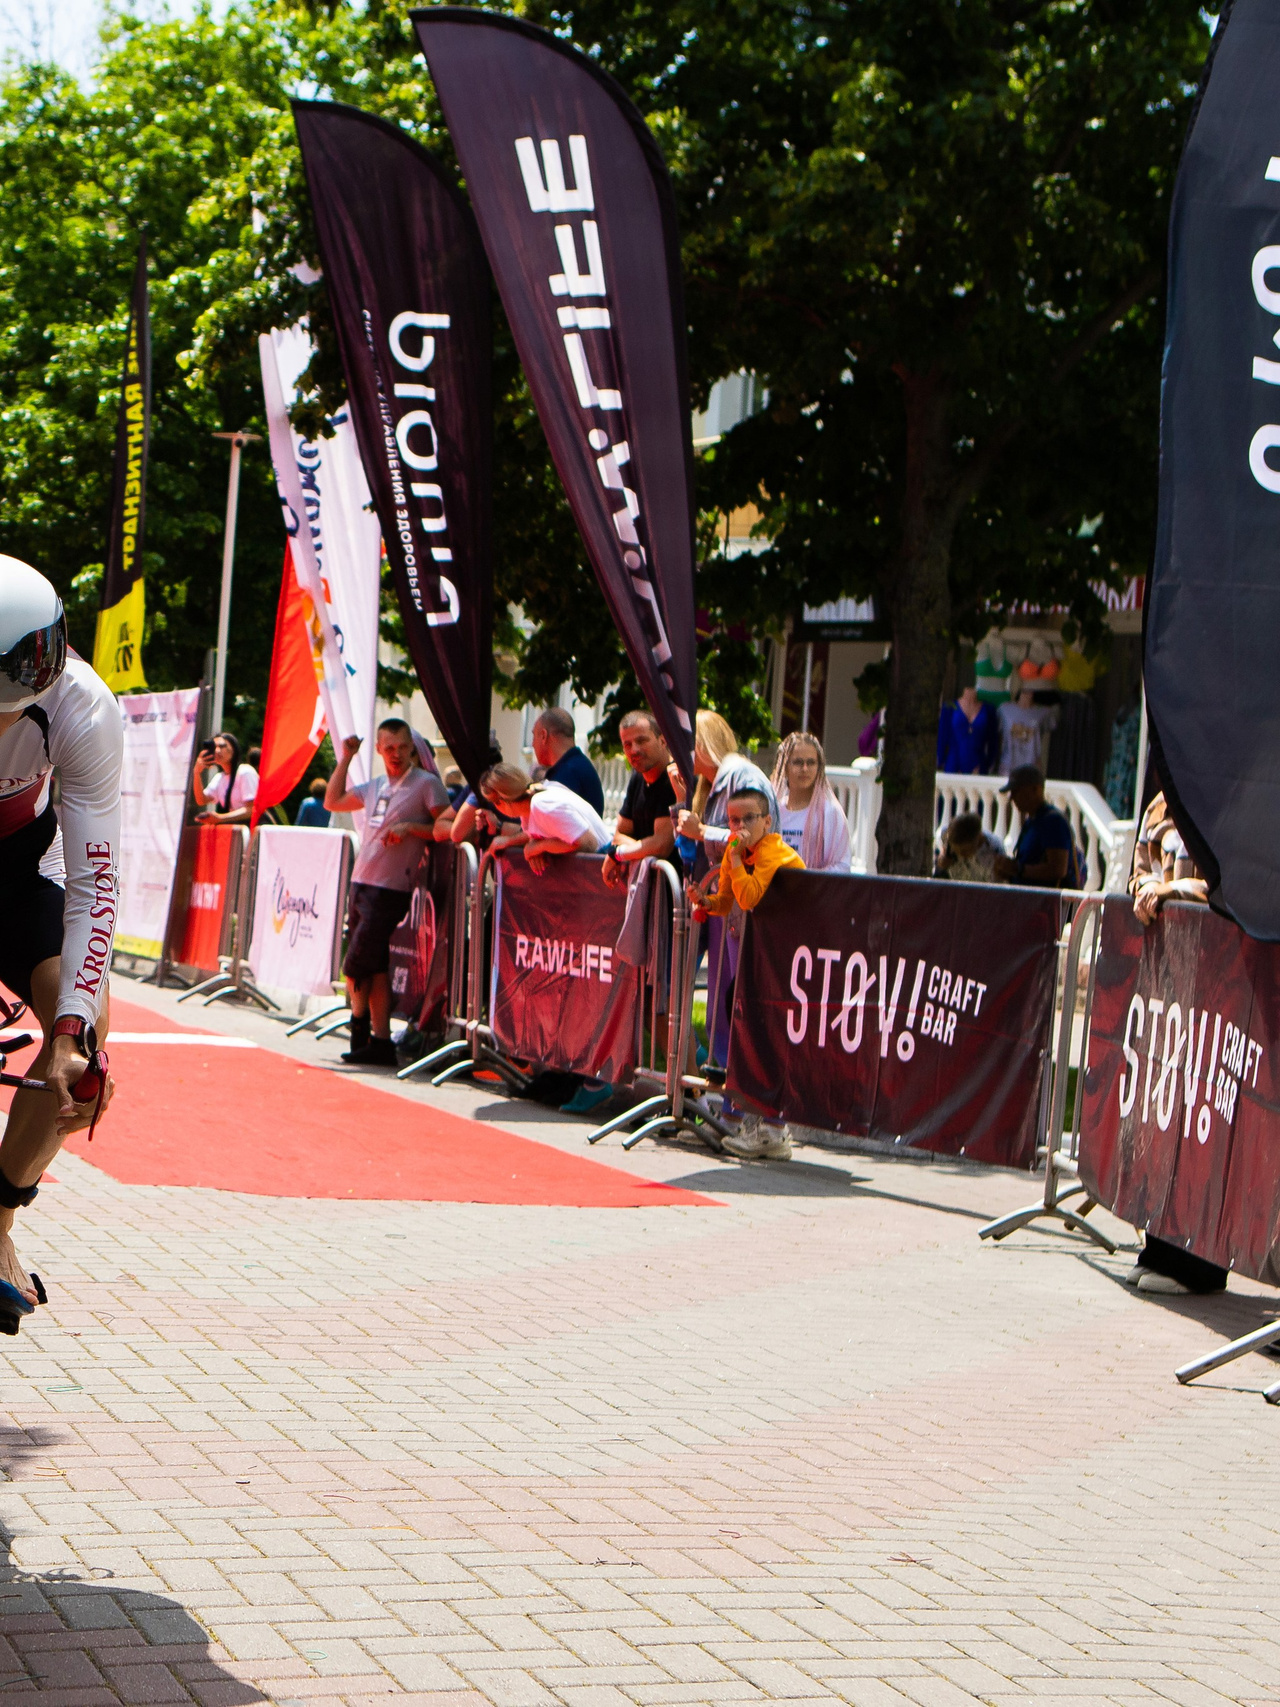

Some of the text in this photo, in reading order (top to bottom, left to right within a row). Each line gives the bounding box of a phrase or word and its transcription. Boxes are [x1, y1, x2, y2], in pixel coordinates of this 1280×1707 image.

[74, 840, 112, 999] KROLSTONE
[515, 933, 613, 984] R.A.W.LIFE
[927, 965, 987, 1018] CRAFT
[920, 1001, 958, 1047] BAR
[1221, 1021, 1263, 1089] CRAFT
[1214, 1067, 1238, 1126] BAR
